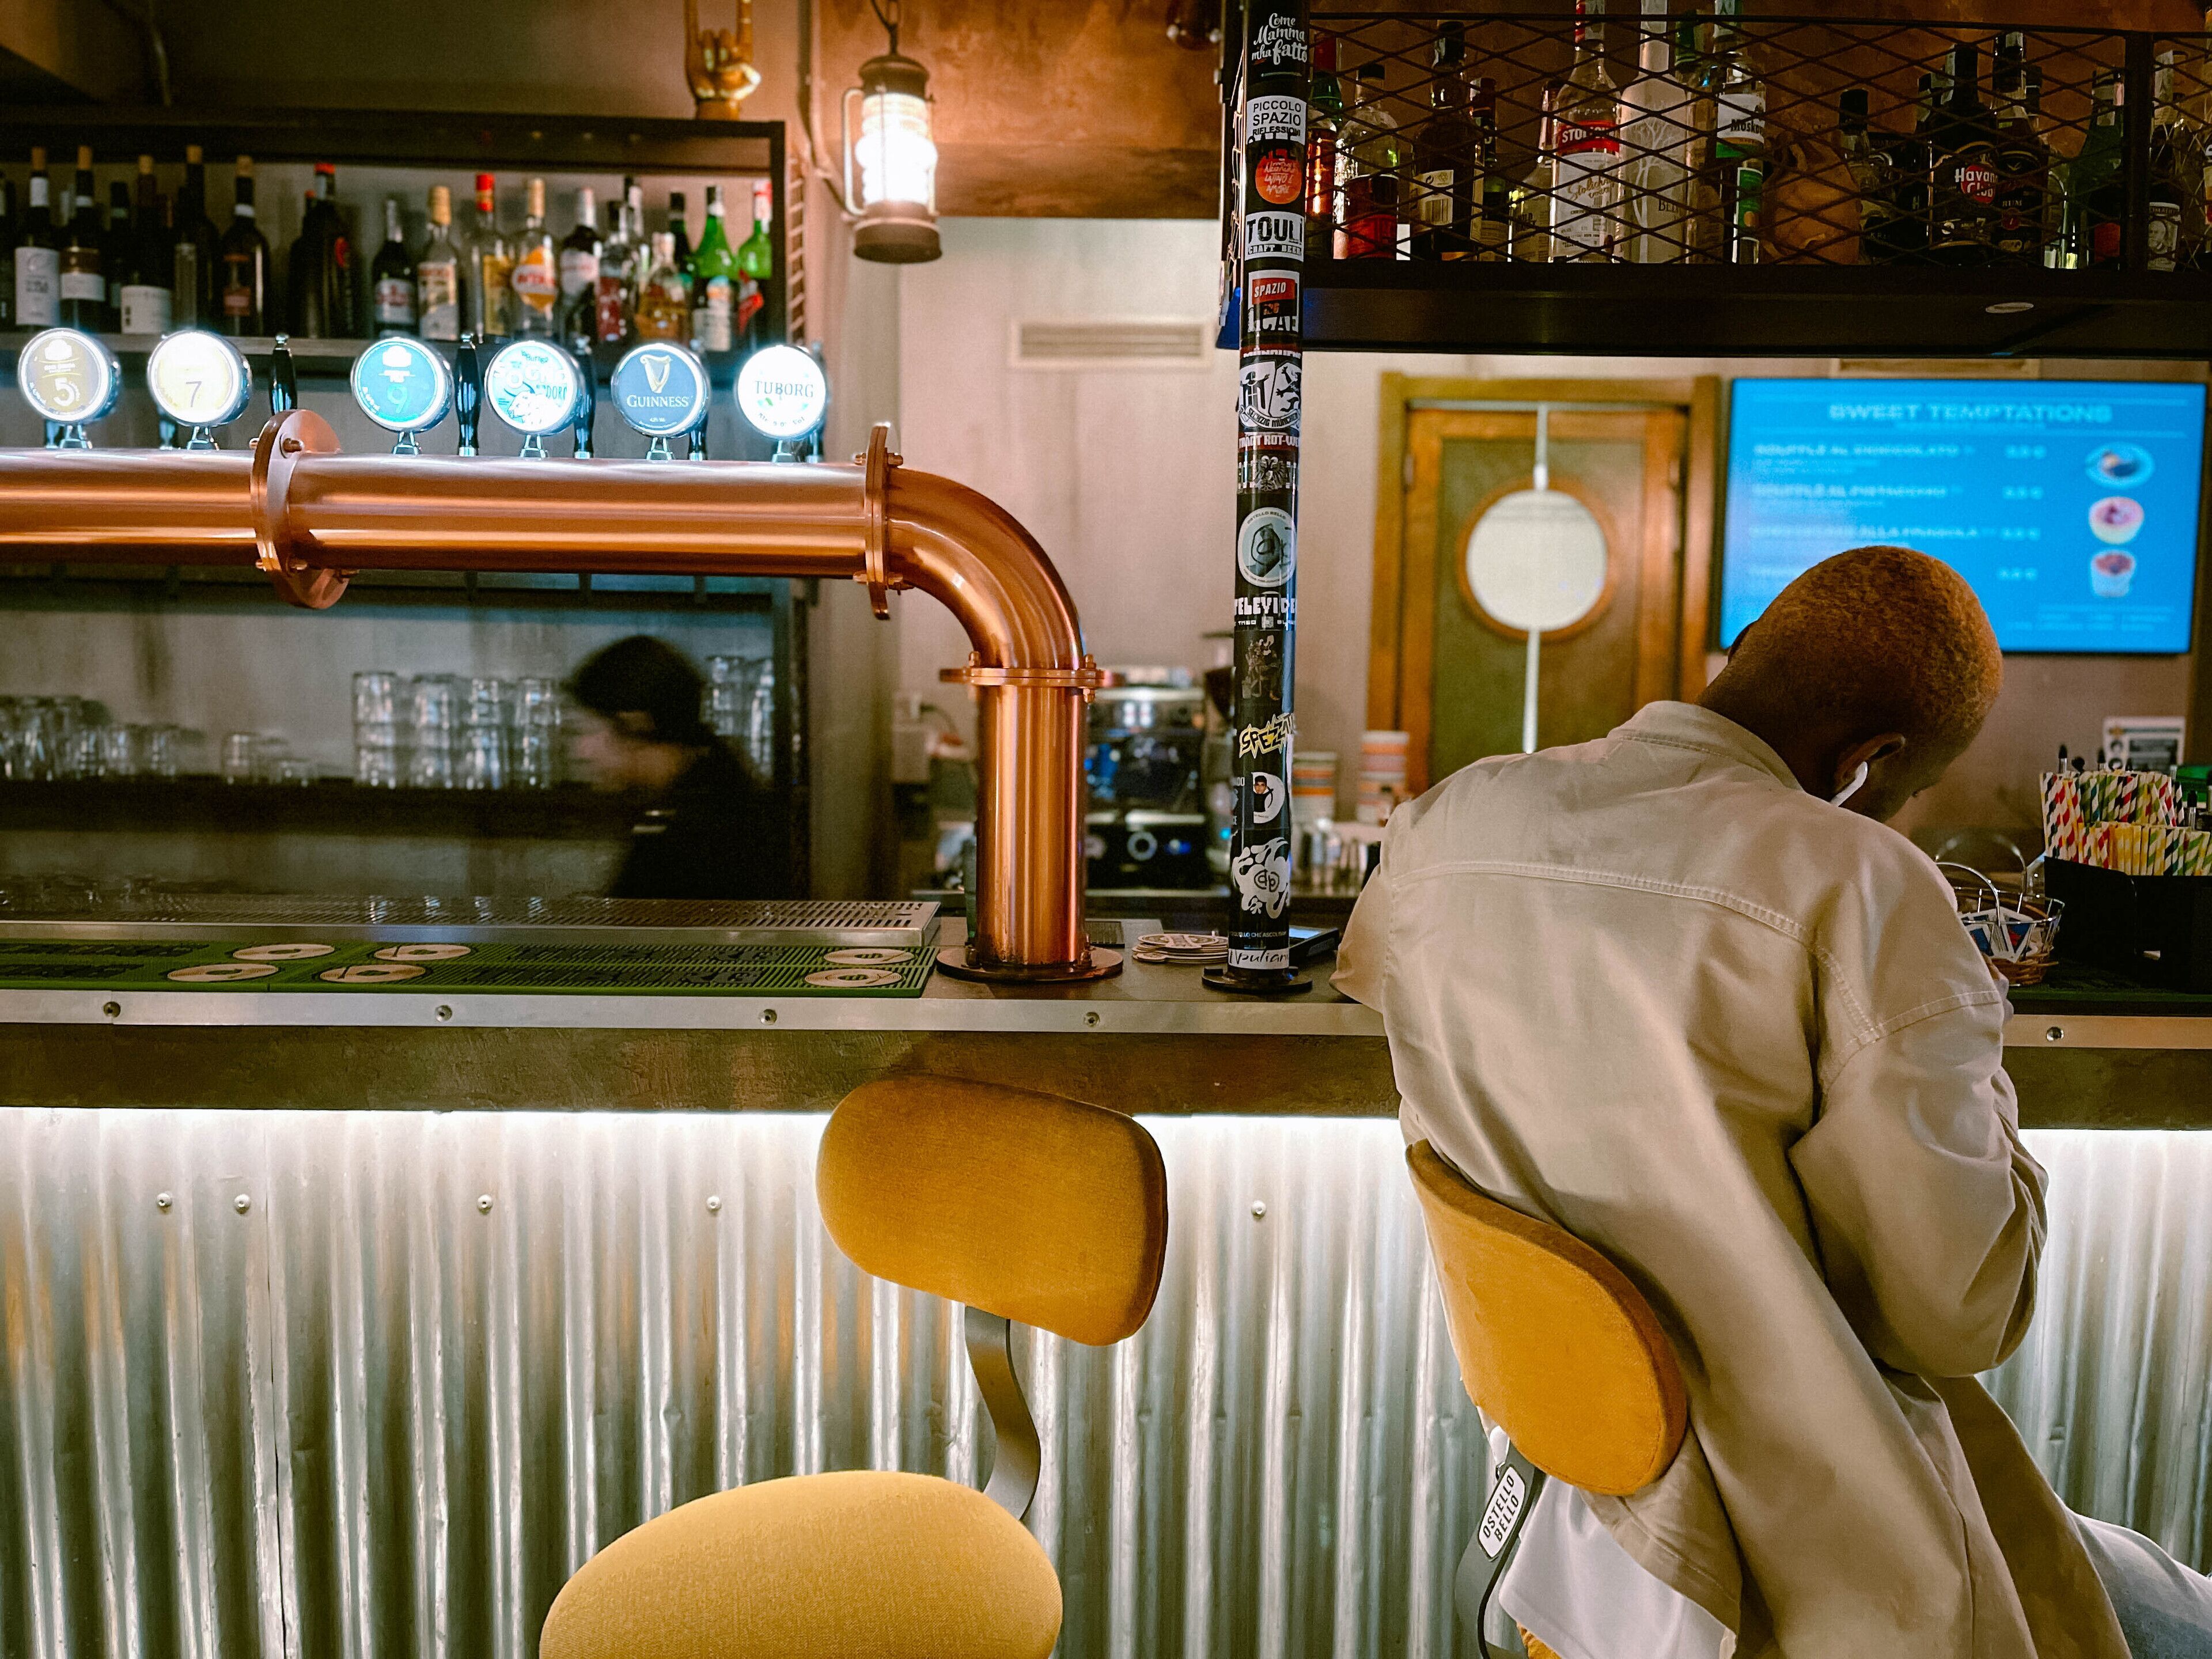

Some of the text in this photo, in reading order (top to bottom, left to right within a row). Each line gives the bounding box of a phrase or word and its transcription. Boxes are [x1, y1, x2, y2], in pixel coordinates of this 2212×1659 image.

[1269, 13, 1296, 28] Come
[1253, 25, 1305, 45] Mamma
[1272, 39, 1308, 65] fatto
[1253, 100, 1301, 112] PICCOLO
[1252, 112, 1301, 126] SPAZIO
[1248, 244, 1302, 255] CRAFT BEER
[1254, 282, 1286, 298] SPAZIO
[53, 377, 75, 406] 5
[185, 380, 202, 408] 7
[387, 383, 408, 414] 9
[755, 380, 814, 398] TUBORG
[626, 395, 690, 408] GUINNESS
[1483, 1474, 1515, 1539] OSTELLO
[1494, 1494, 1519, 1542] BELLO
